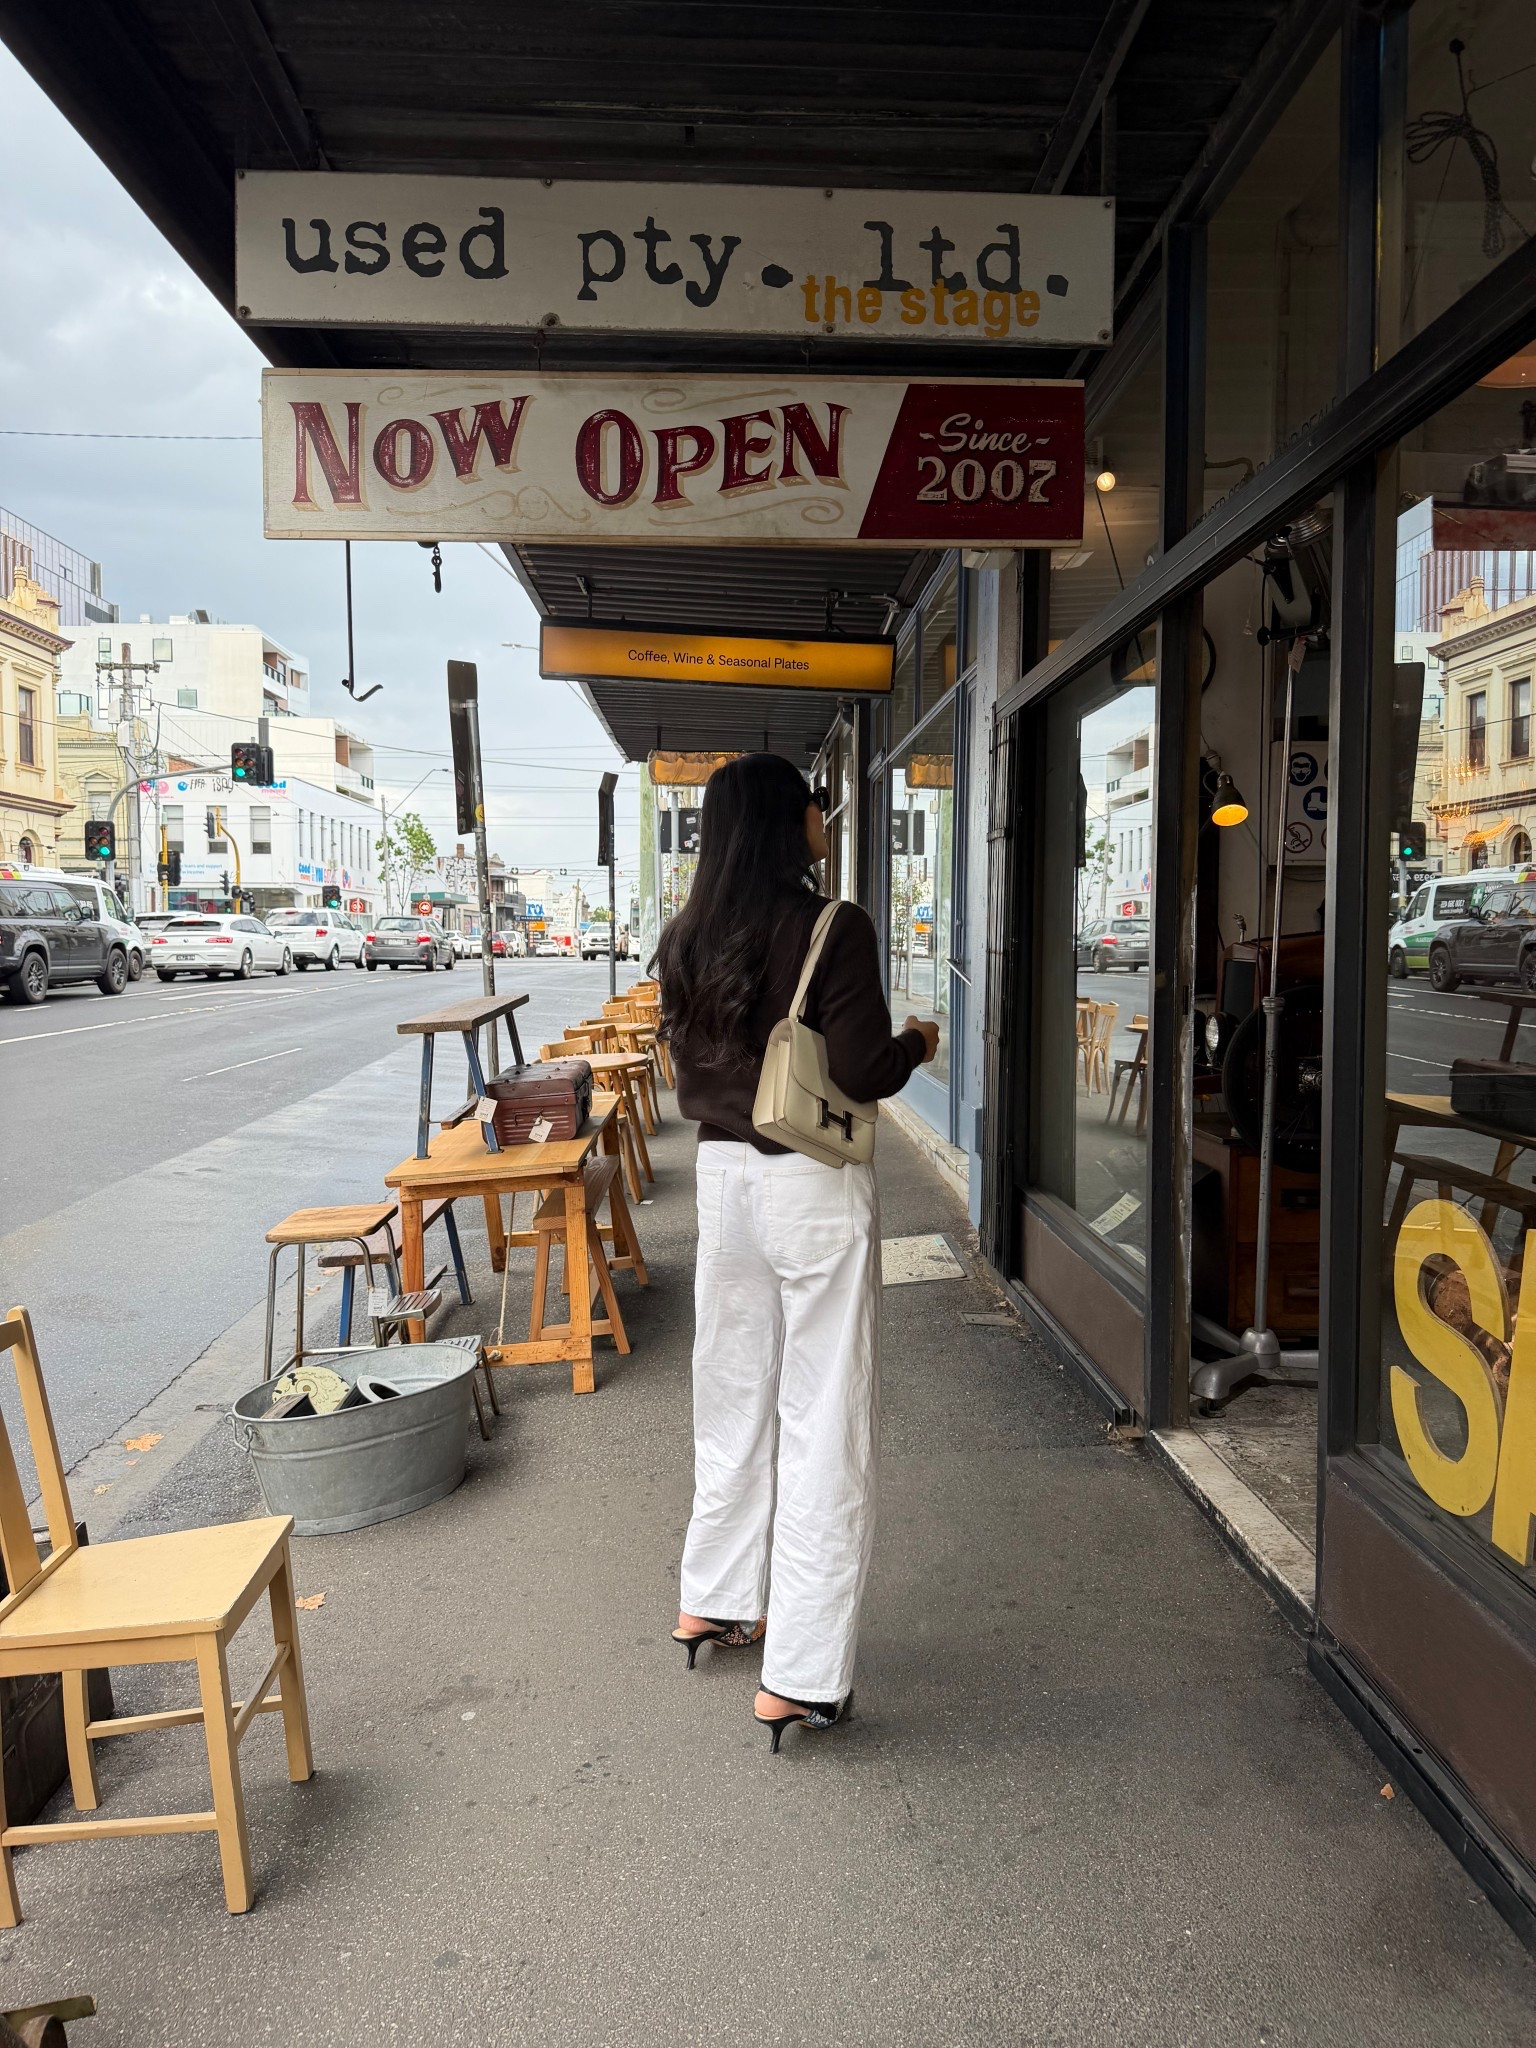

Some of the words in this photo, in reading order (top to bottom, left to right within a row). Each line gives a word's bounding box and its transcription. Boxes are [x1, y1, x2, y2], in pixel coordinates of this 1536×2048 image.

[281, 207, 510, 279] used
[577, 215, 794, 308] pty.
[863, 220, 1070, 299] ltd.
[801, 275, 884, 323] the
[900, 278, 1041, 337] stage
[287, 395, 537, 513] NOW
[574, 402, 853, 508] OPEN
[915, 455, 1059, 505] 2007
[628, 649, 670, 665] Coffee,
[673, 652, 704, 665] Wine
[706, 654, 715, 665] &
[718, 654, 771, 669] Seasonal
[774, 657, 810, 671] Plates
